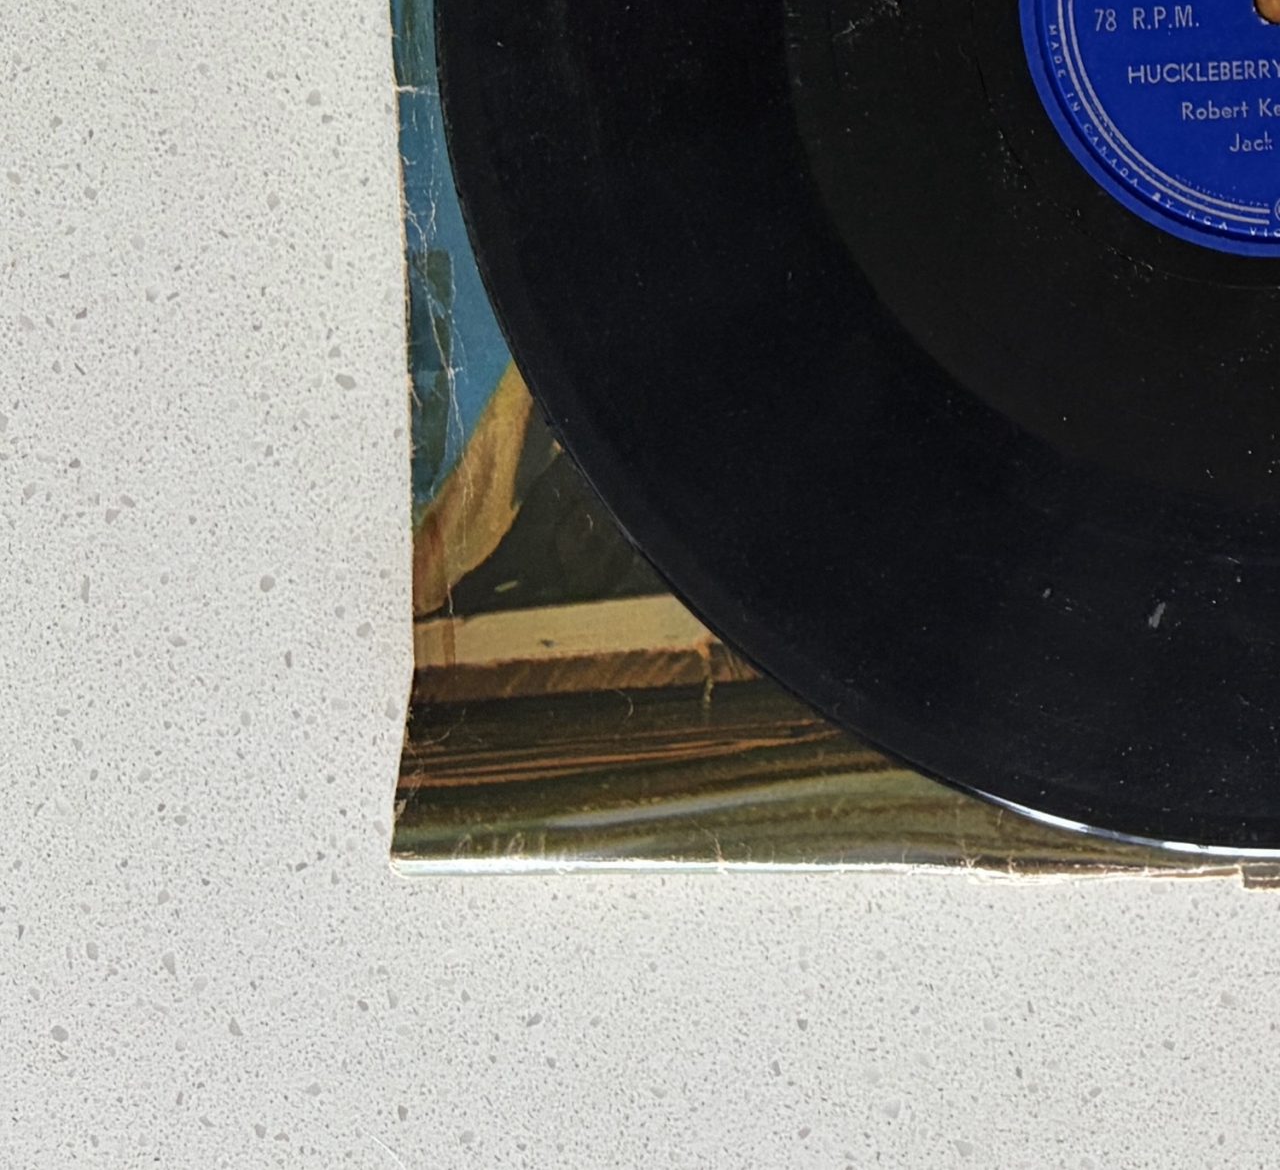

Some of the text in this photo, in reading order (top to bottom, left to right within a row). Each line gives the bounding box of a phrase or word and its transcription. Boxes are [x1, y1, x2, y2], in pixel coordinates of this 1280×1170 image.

[1094, 4, 1200, 32] 78 R.P.M.
[1181, 100, 1249, 121] Robert
[1048, 23, 1068, 79] MADE
[1066, 91, 1082, 115] IN
[1083, 123, 1140, 188] CANADA
[1186, 209, 1228, 231] RCA
[1229, 131, 1274, 153] Jack
